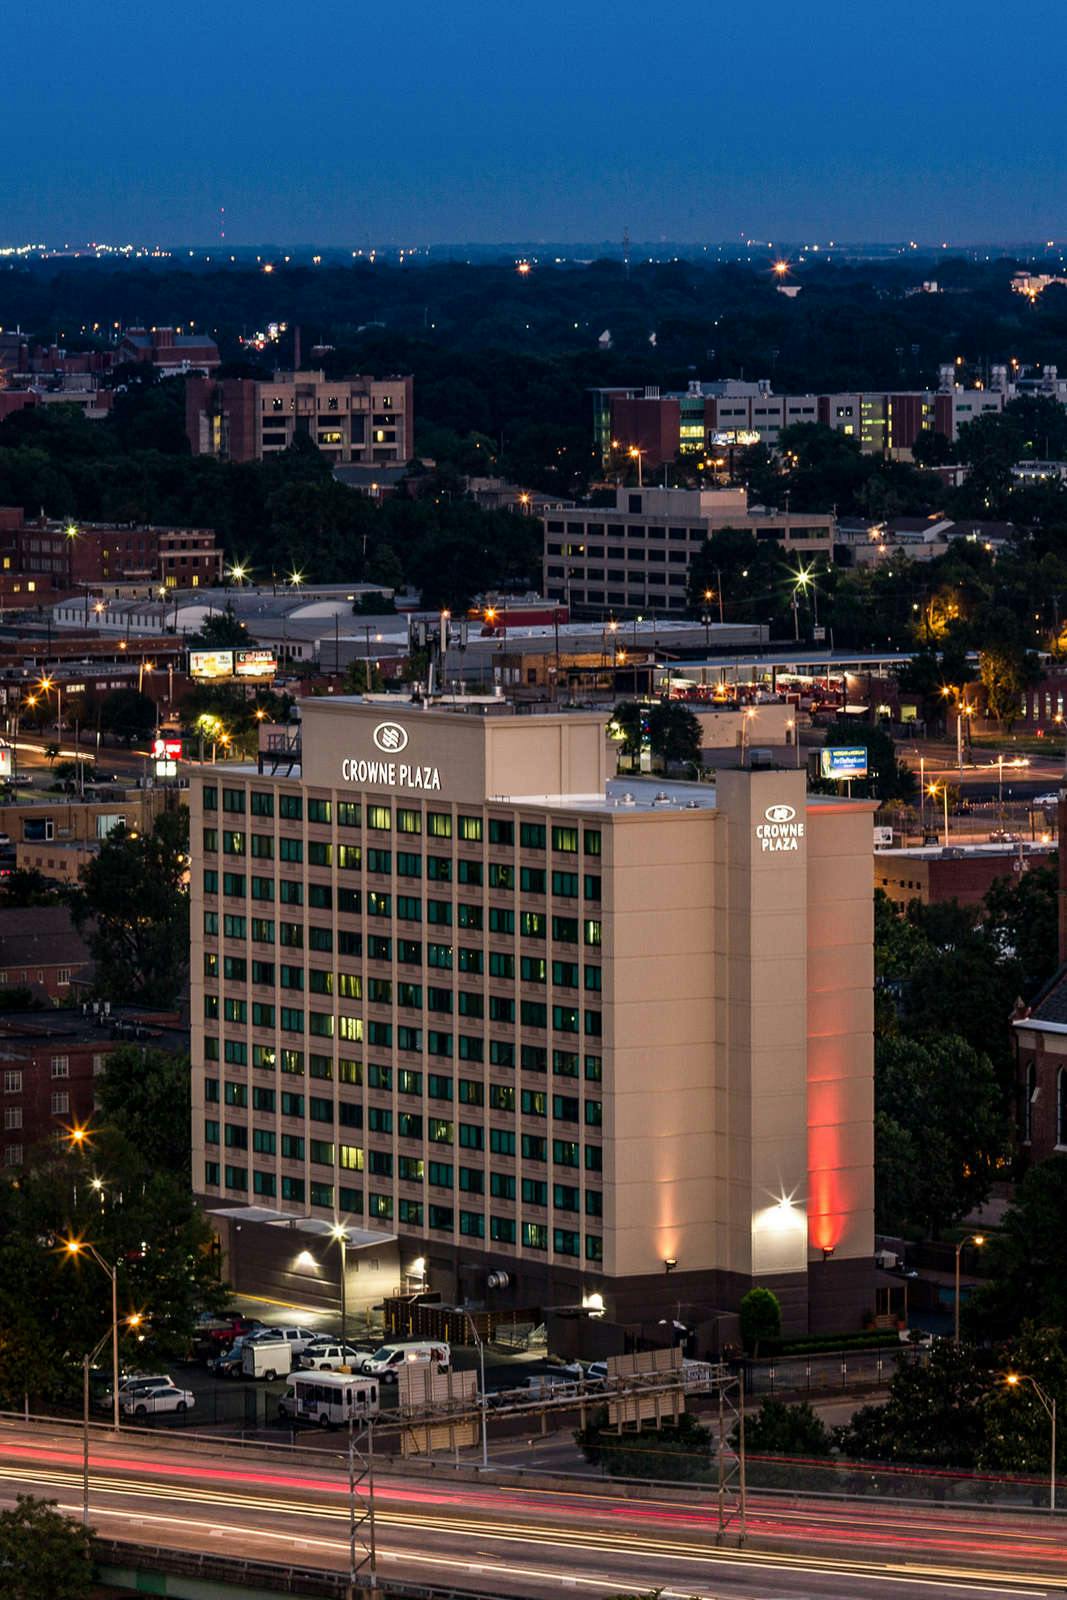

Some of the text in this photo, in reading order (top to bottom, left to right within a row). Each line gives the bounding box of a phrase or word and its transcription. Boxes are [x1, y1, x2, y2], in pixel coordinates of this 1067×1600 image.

[342, 759, 441, 790] CROWNE PLAZA
[756, 823, 804, 839] CROWNE
[761, 837, 798, 852] PLAZA
